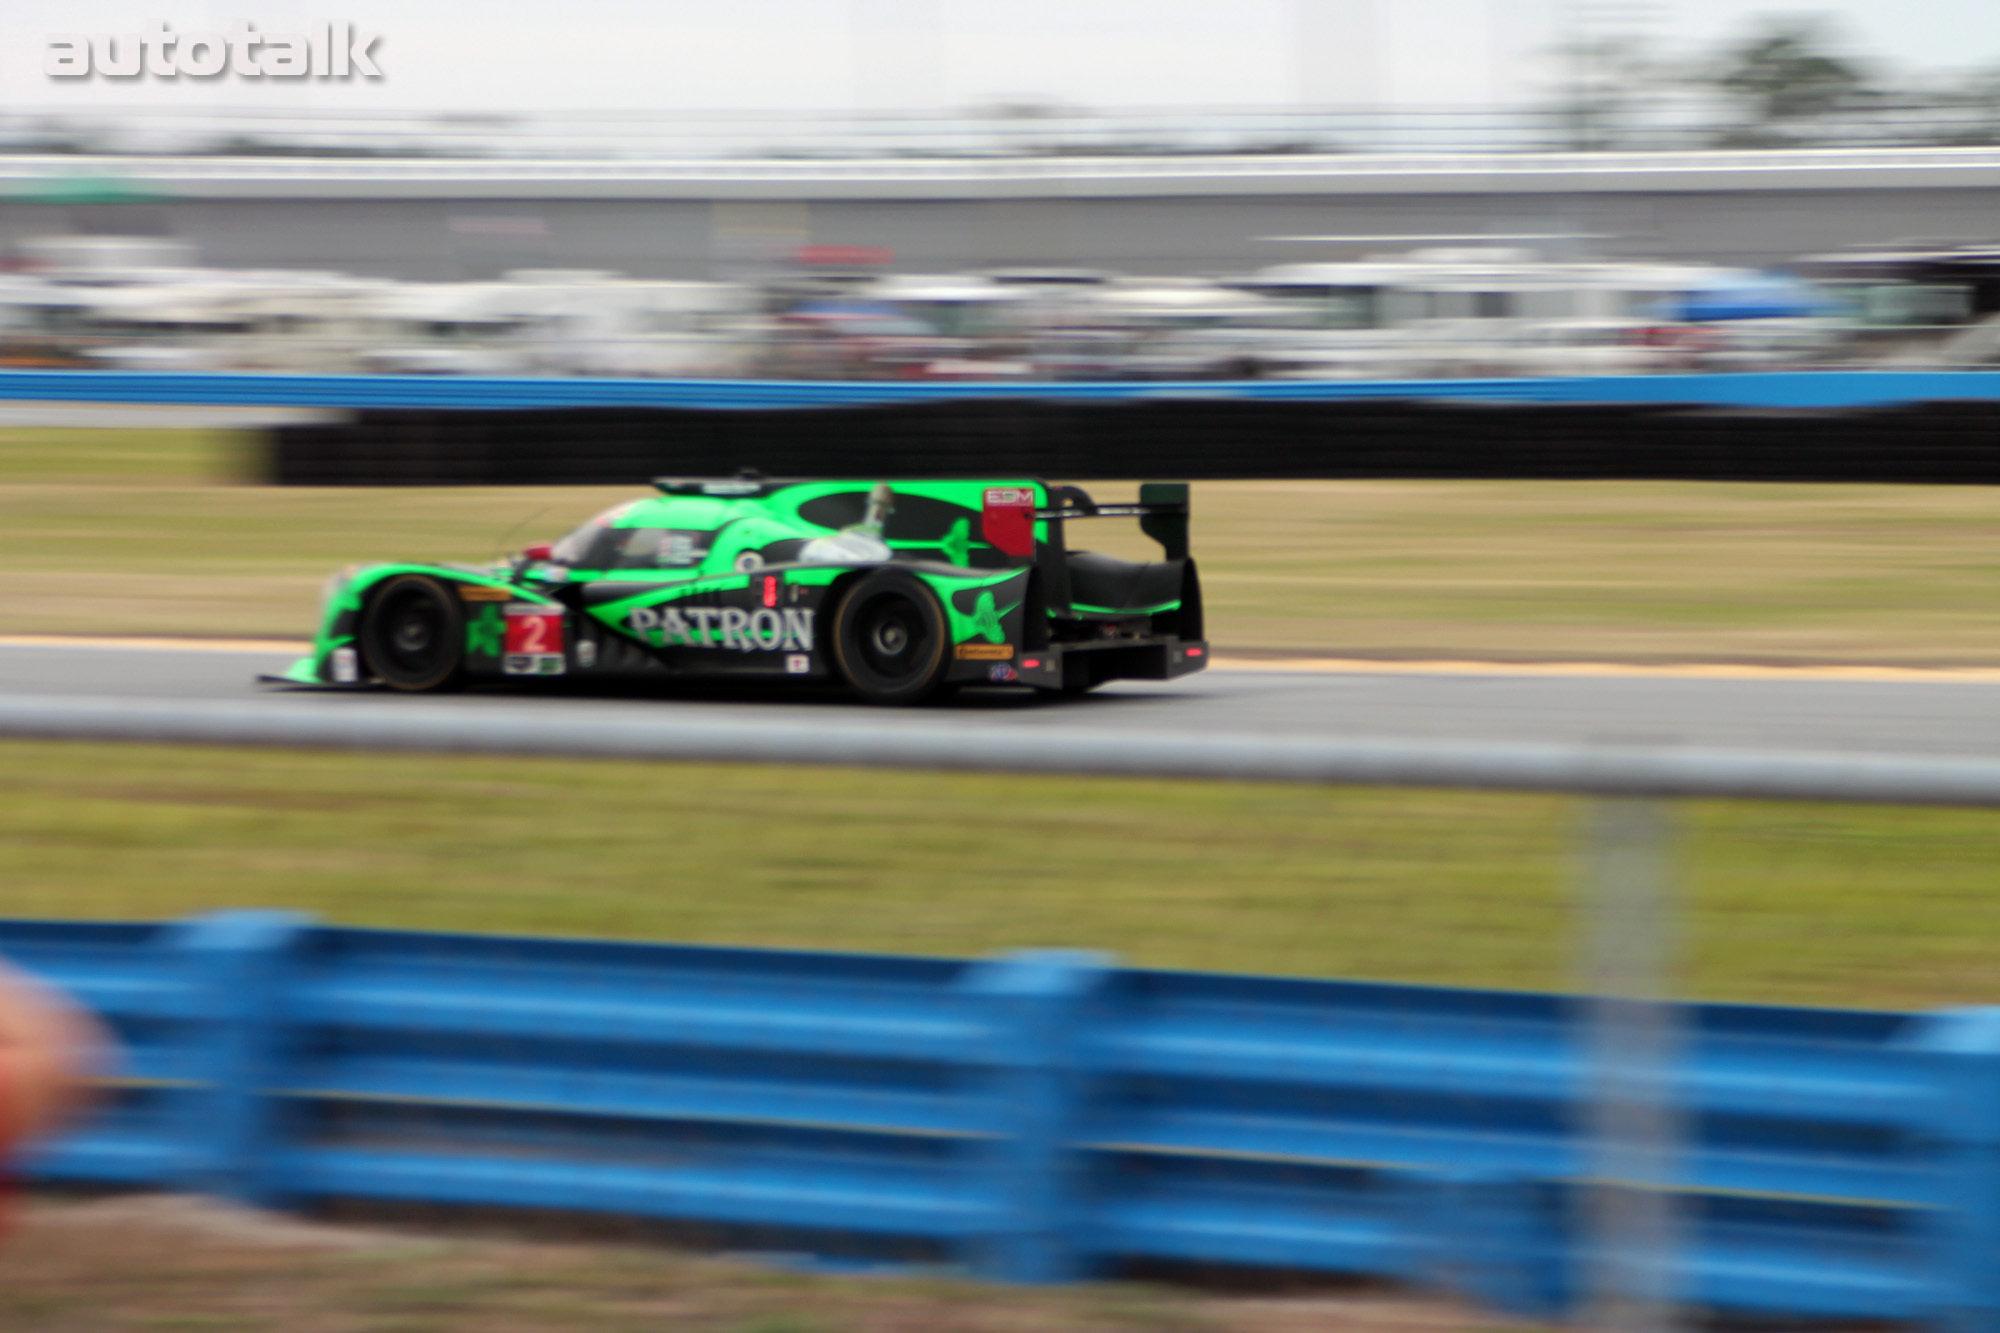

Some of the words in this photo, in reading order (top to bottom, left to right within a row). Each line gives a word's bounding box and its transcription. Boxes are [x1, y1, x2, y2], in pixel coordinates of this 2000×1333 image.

[987, 490, 1033, 504] ESM
[522, 616, 547, 653] 2
[629, 606, 814, 652] PATRON
